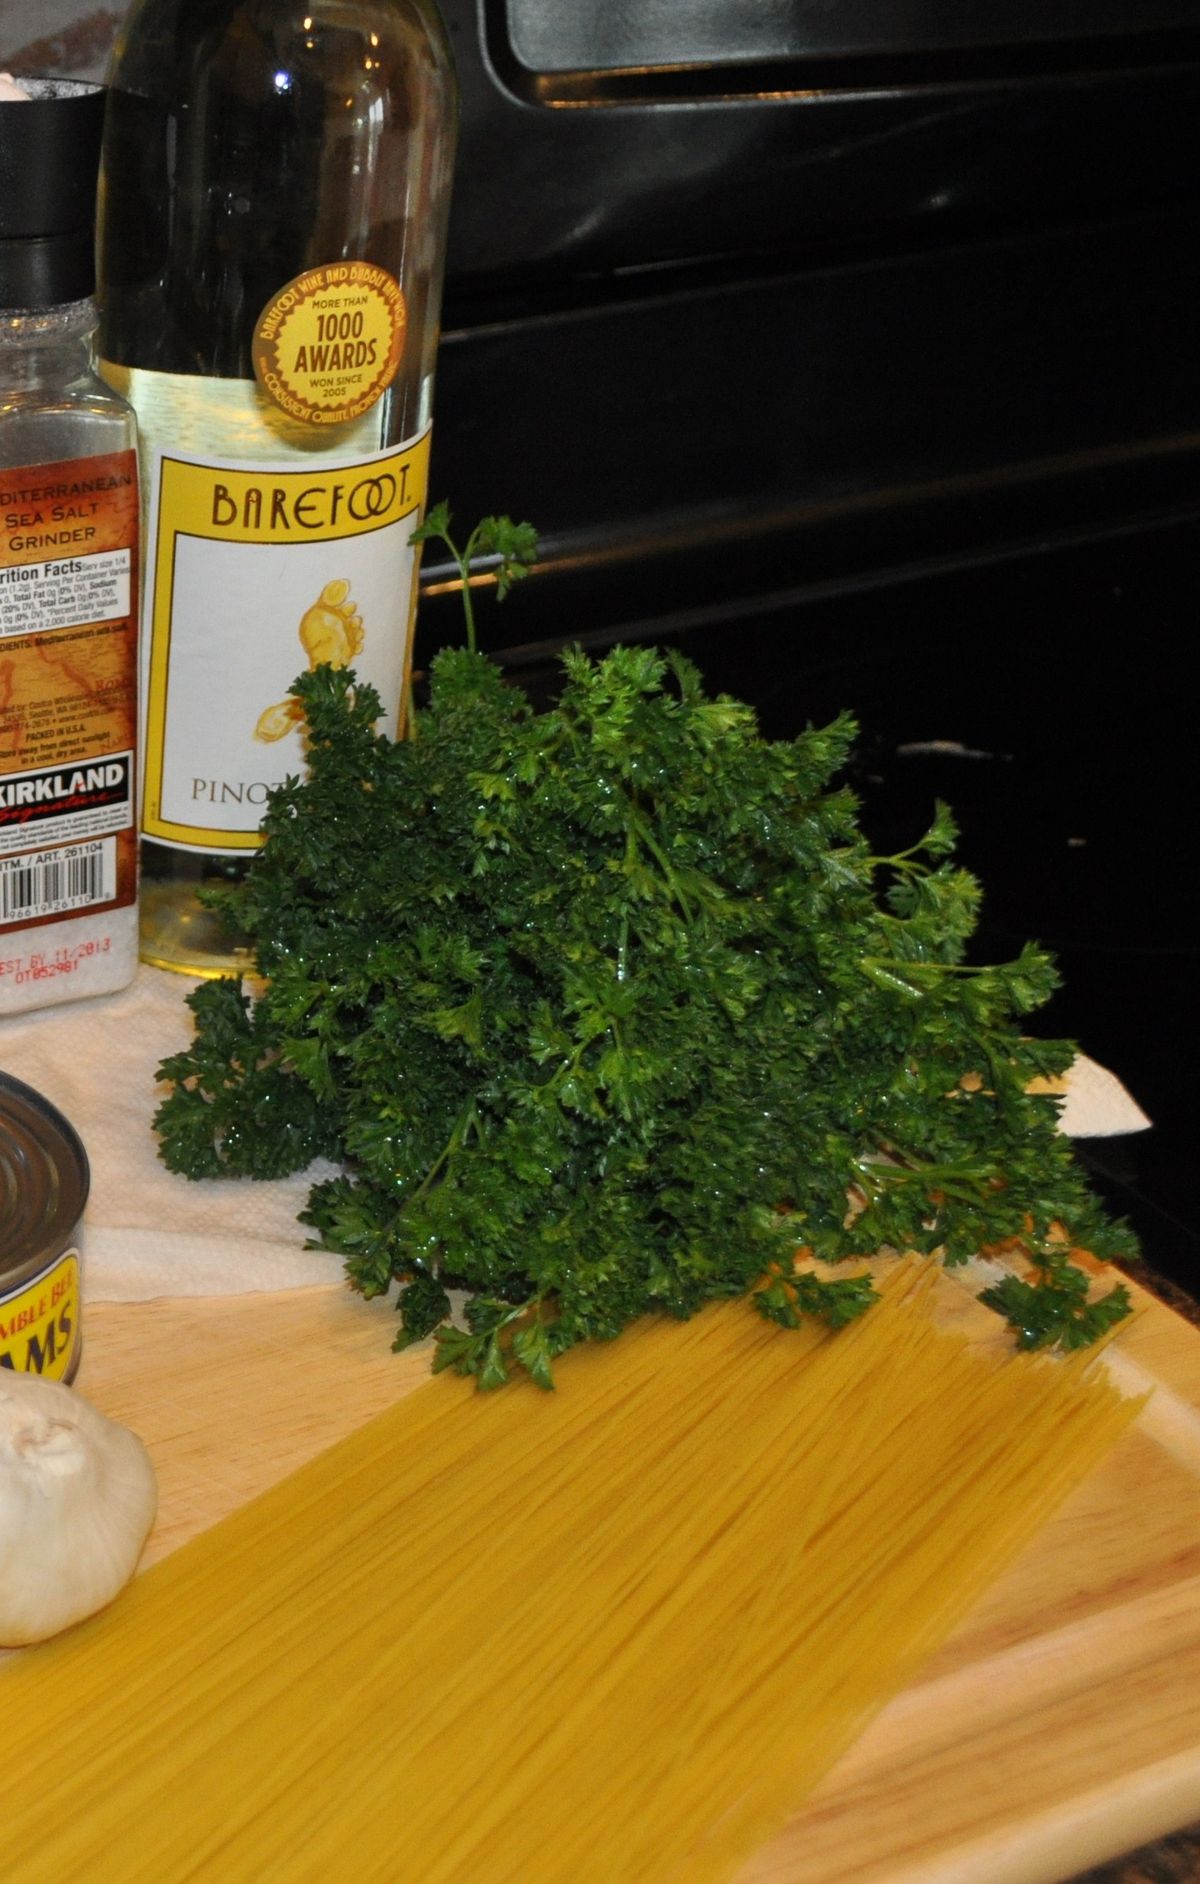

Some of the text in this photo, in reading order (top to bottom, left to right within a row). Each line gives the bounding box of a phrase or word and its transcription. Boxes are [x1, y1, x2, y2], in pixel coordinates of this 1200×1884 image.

[260, 287, 299, 340] BAREFOOT
[298, 272, 324, 293] WINE
[326, 267, 349, 283] AND
[312, 296, 368, 309] MORE THAN
[316, 311, 364, 342] 1000
[293, 338, 378, 373] AWARDS
[310, 374, 363, 388] WON SINCE
[322, 388, 346, 398] 2005
[211, 464, 411, 529] BAREFOOT
[5, 503, 99, 530] SEA SALT
[8, 527, 96, 551] GRINDER
[44, 558, 81, 578] Facts
[0, 858, 22, 871] ITM.
[35, 850, 61, 865] ART.
[64, 842, 103, 858] 261104
[9, 904, 47, 920] 96619
[30, 953, 46, 967] BY
[51, 1269, 75, 1306] BEE
